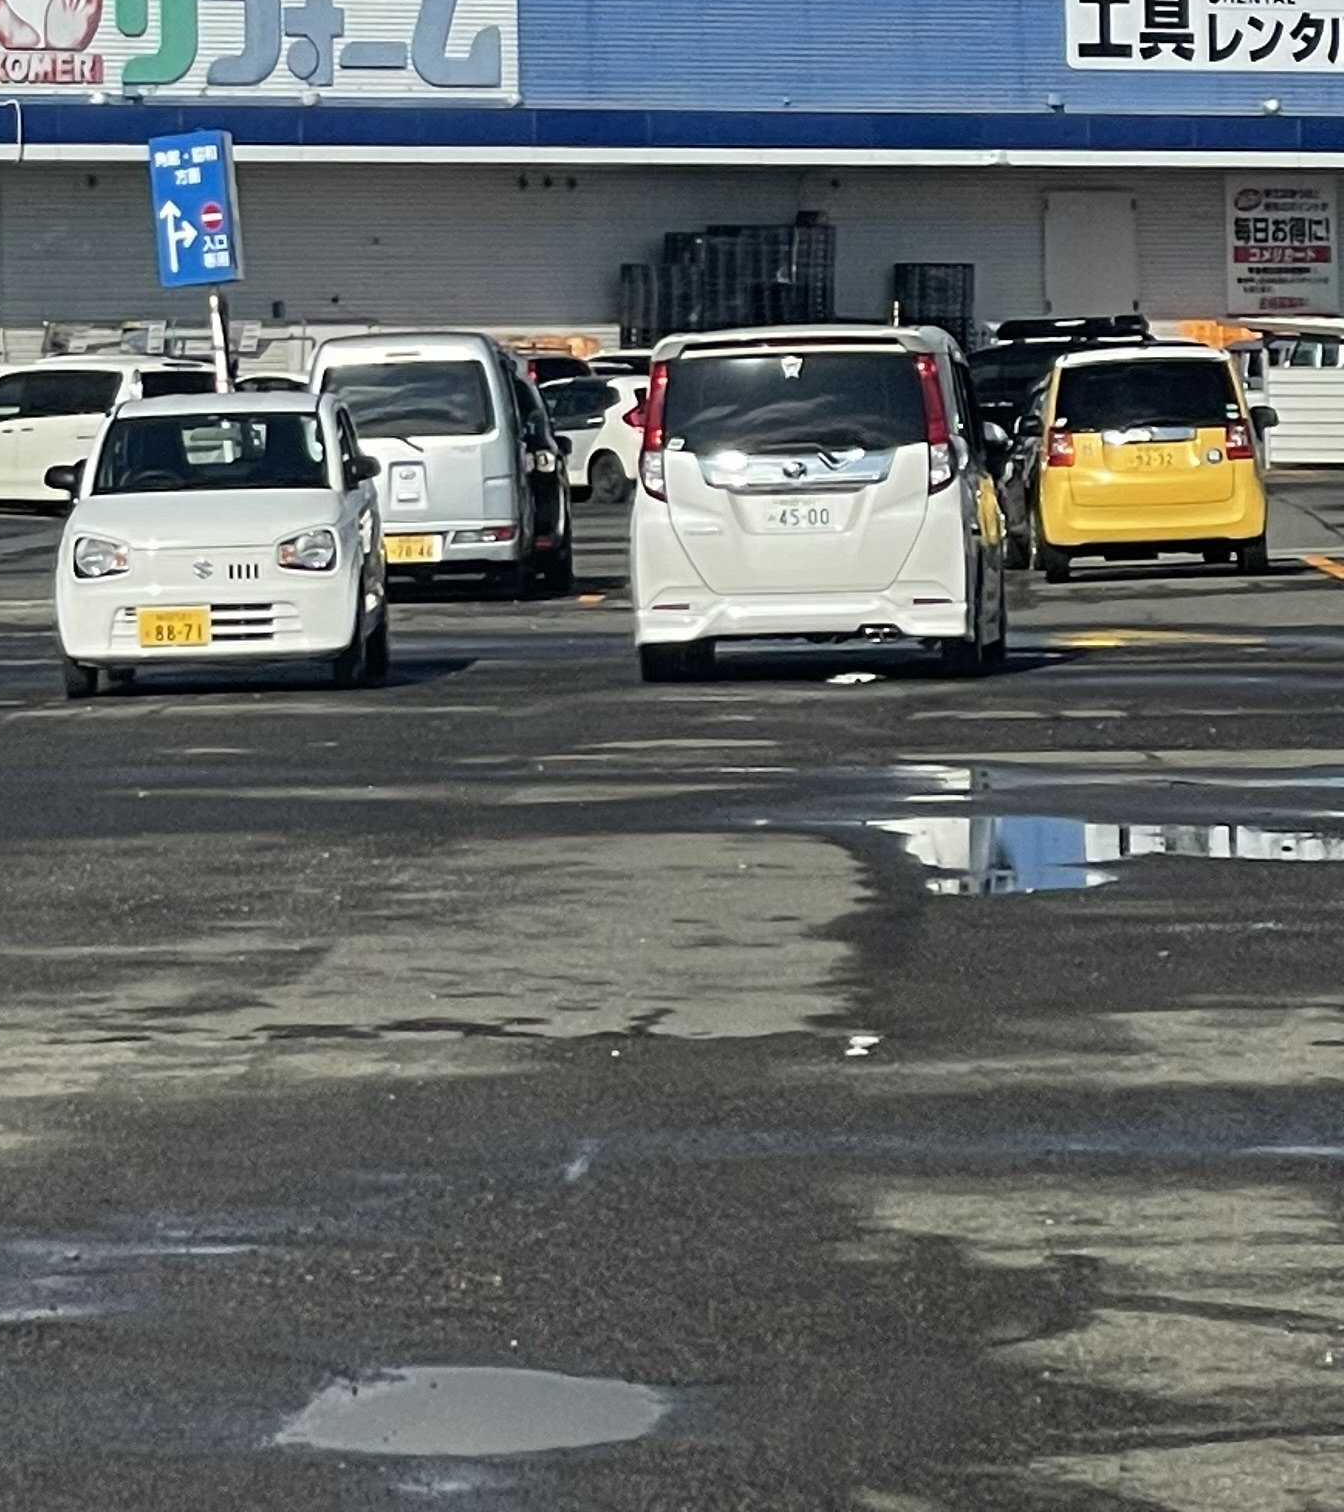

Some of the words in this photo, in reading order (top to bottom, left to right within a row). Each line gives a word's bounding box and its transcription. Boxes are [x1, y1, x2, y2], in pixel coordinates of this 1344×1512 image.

[203, 234, 228, 252] 入口
[779, 508, 830, 526] 45-00
[155, 623, 203, 641] 88-71
